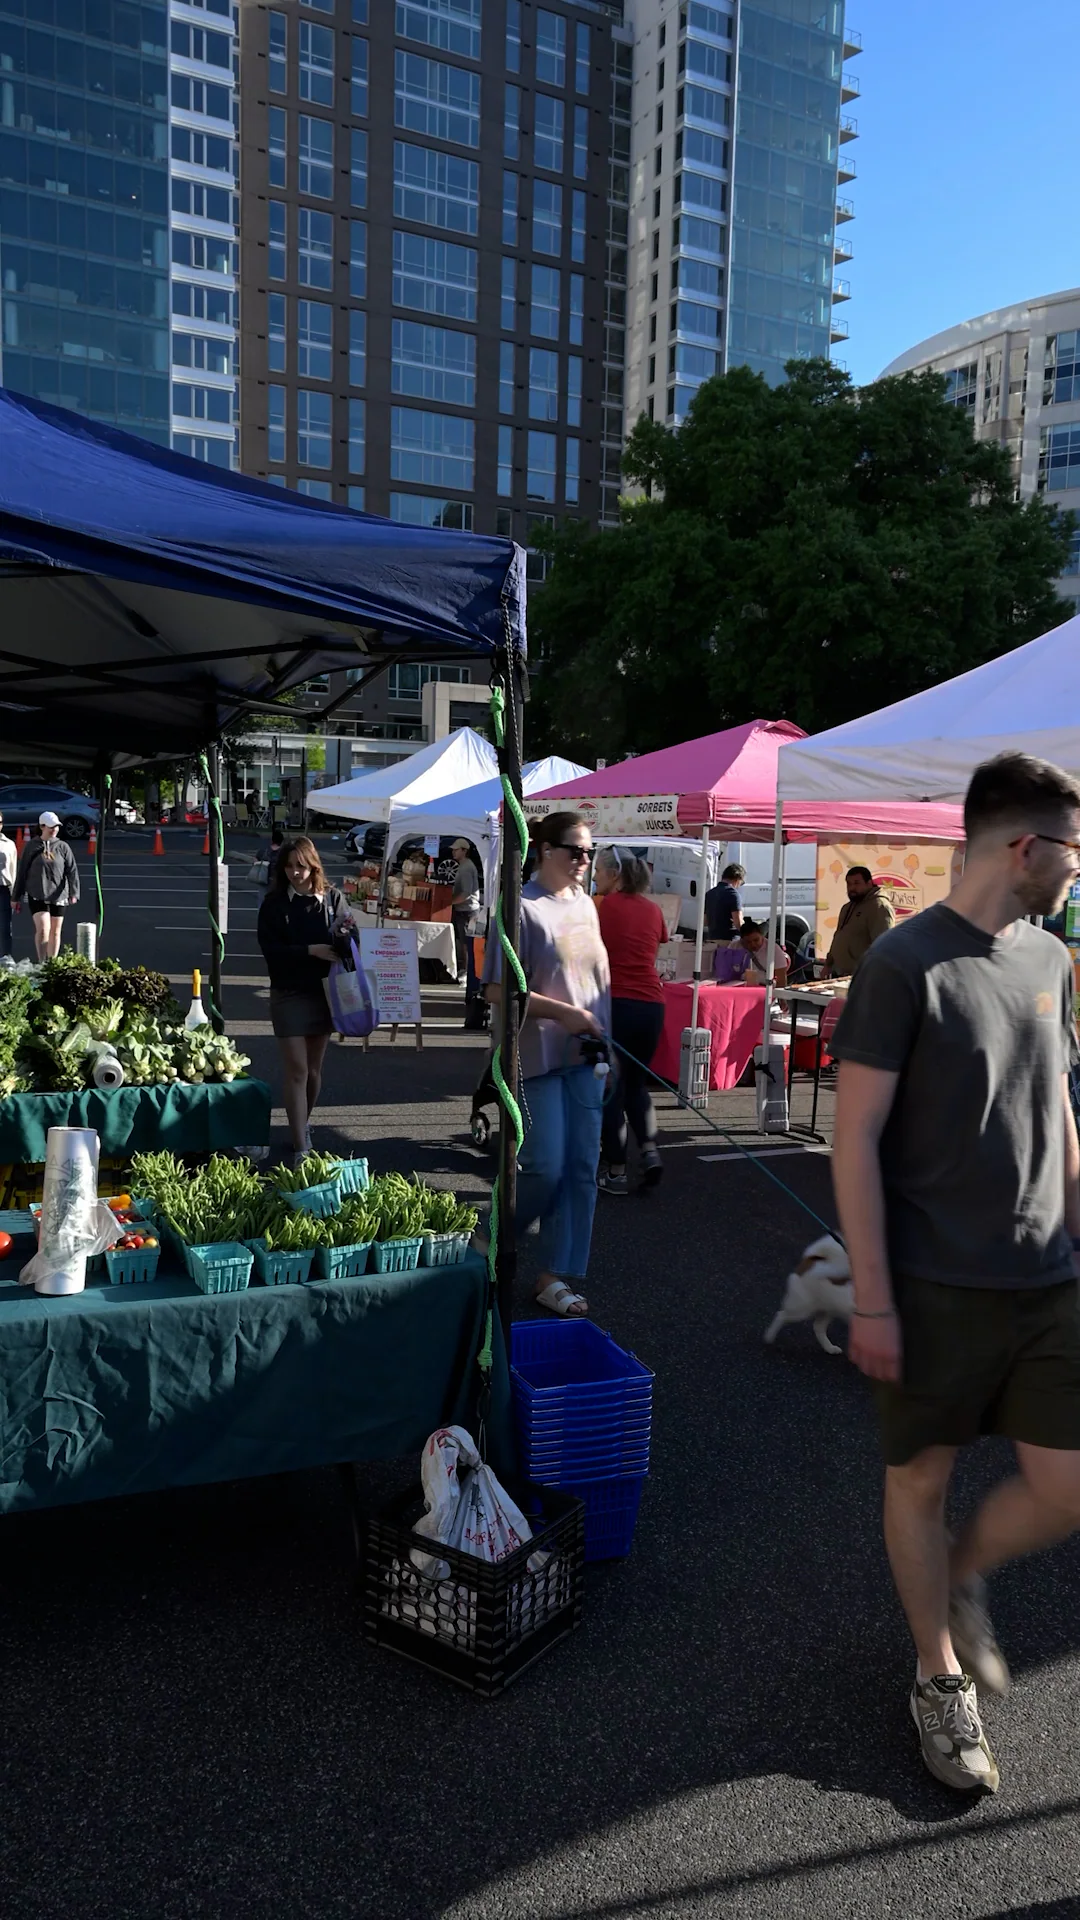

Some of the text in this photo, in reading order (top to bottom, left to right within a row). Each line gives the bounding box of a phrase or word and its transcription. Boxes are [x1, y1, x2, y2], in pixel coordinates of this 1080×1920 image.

[637, 801, 673, 813] SORBETS
[645, 819, 675, 830] JUICES
[890, 891, 918, 906] Twist
[922, 1711, 941, 1732] N
